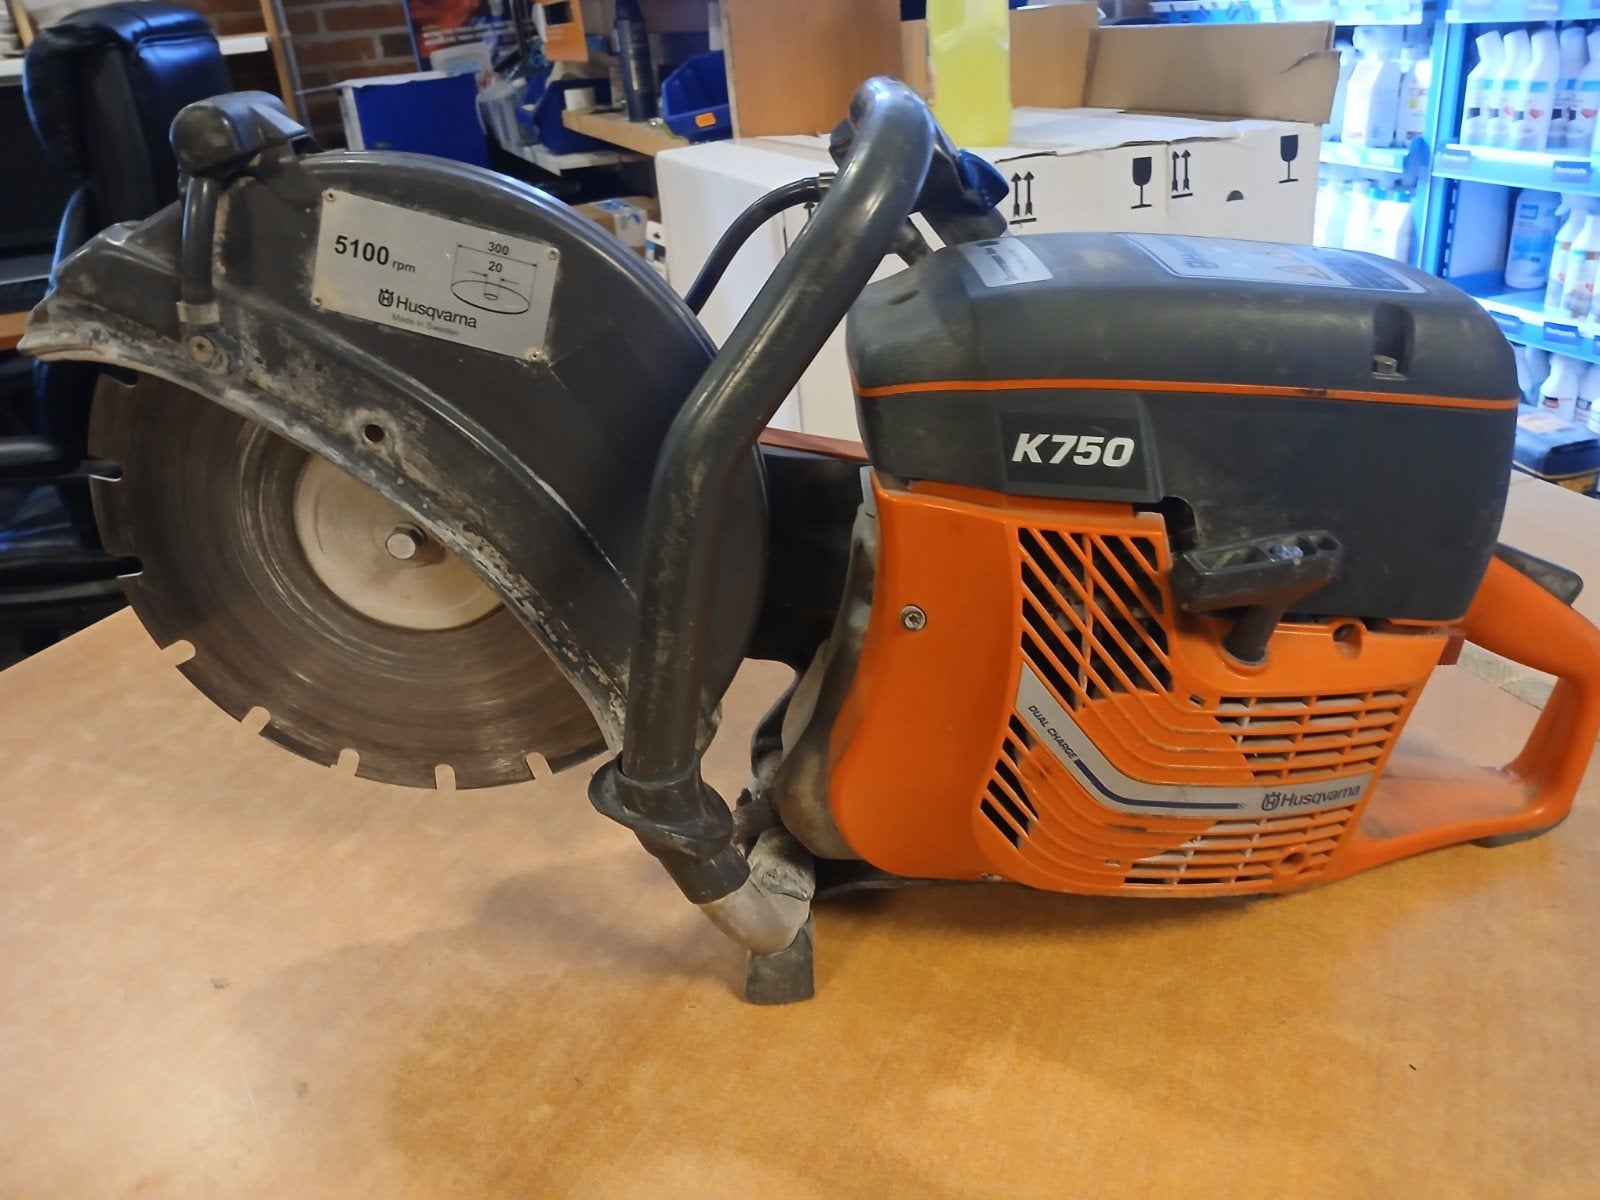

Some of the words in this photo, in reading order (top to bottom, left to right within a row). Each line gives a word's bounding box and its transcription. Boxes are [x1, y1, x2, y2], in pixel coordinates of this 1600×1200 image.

[334, 234, 390, 266] 5100
[391, 259, 416, 273] rpm
[488, 241, 510, 256] 300
[488, 261, 503, 273] 20
[392, 313, 415, 326] Made
[426, 322, 459, 336] Sweden
[396, 295, 477, 328] Husqvarna
[1011, 432, 1135, 468] K750
[1028, 705, 1049, 728] DUAL
[1047, 727, 1078, 760] CHARGE
[1280, 785, 1360, 807] Husqvarna
